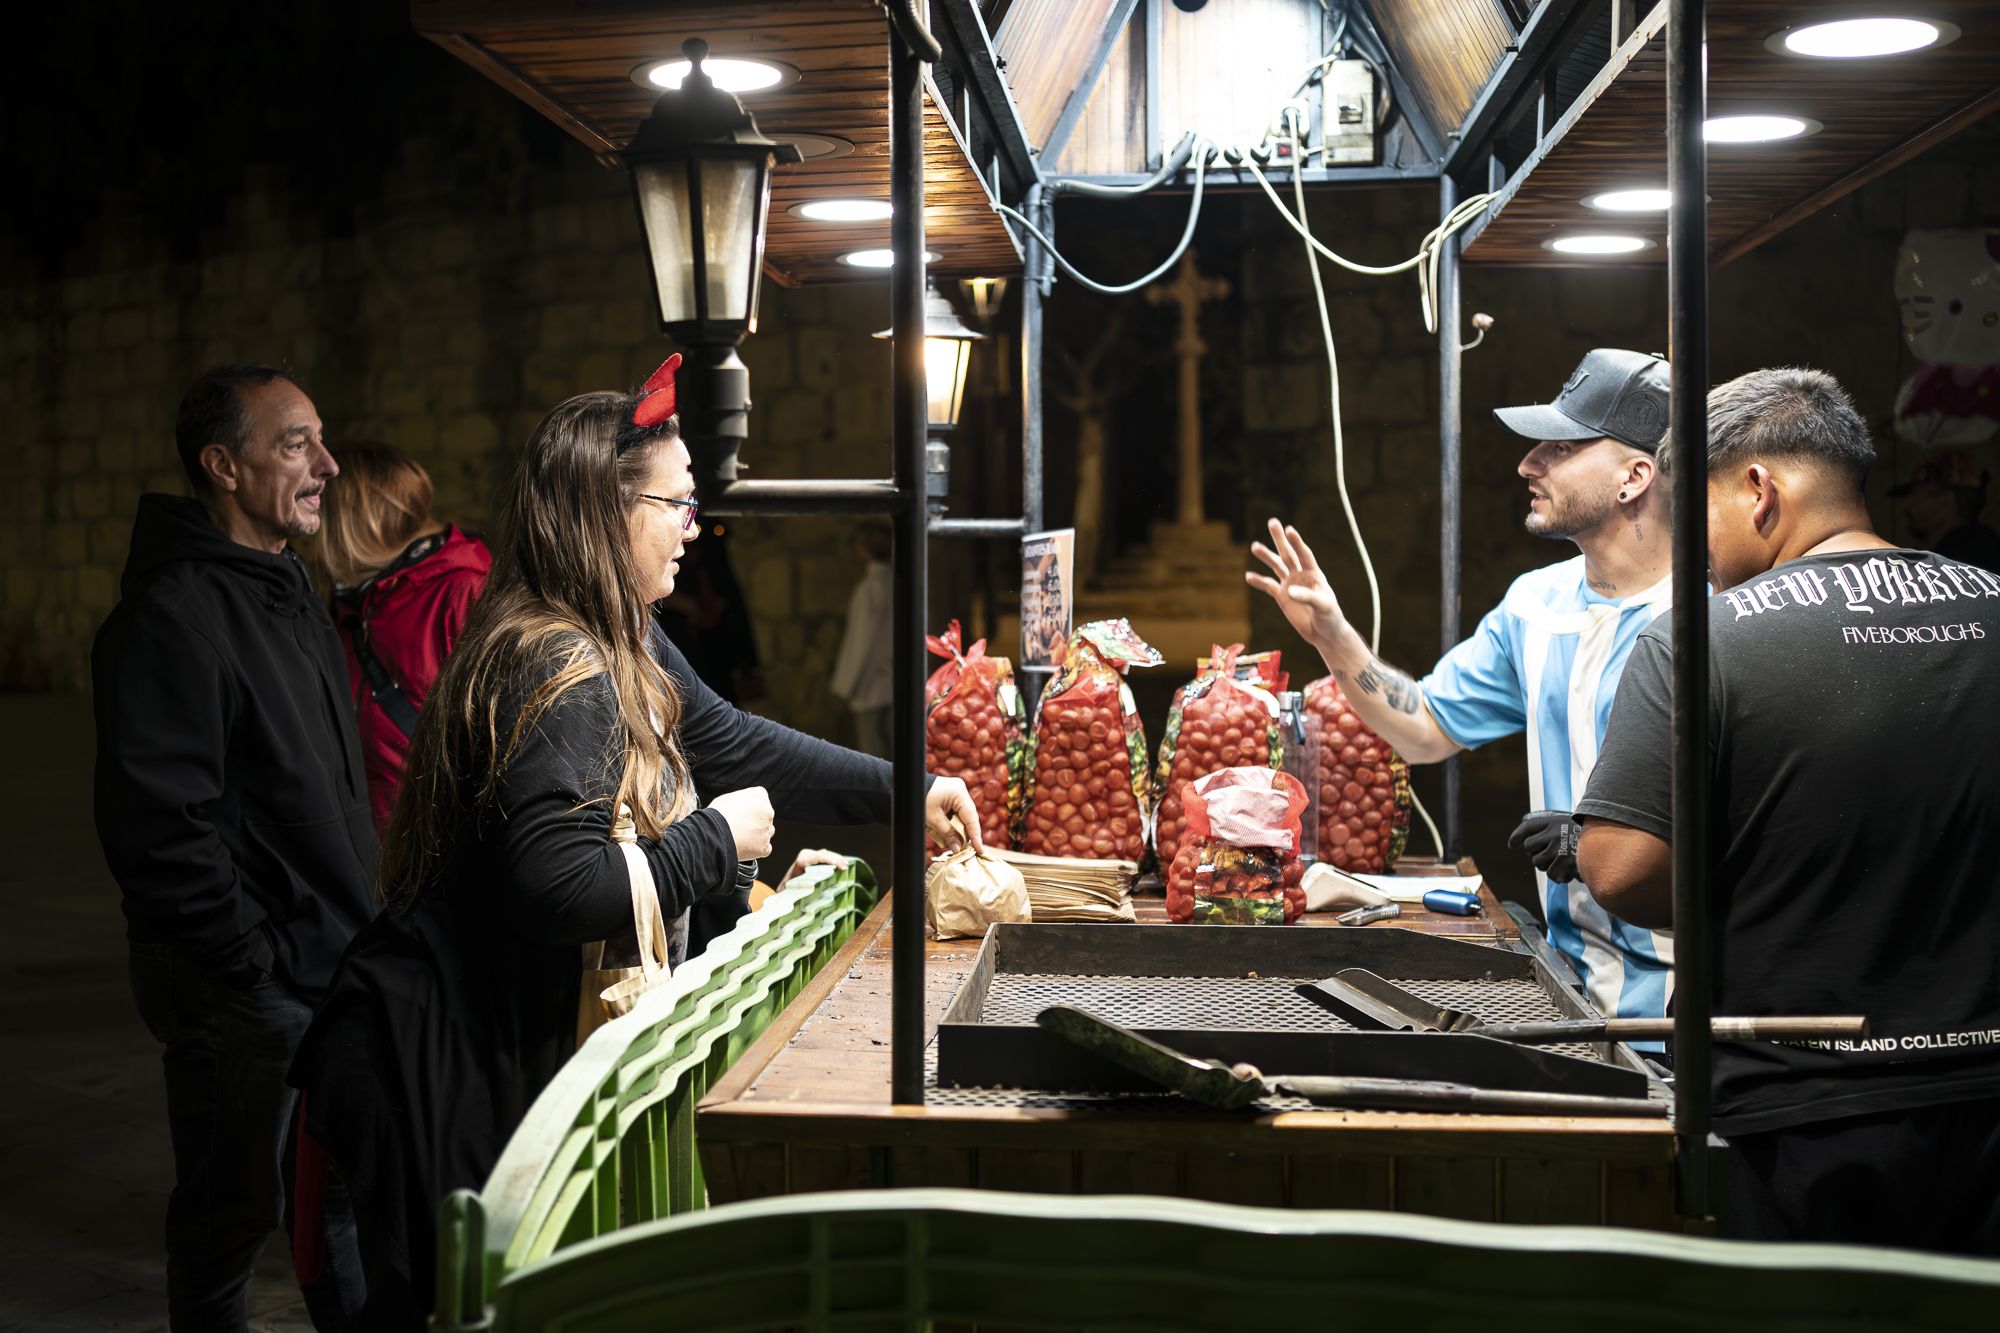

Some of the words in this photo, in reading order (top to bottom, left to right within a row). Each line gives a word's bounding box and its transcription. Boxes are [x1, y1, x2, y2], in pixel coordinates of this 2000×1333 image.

[1721, 568, 1827, 622] NEW
[1834, 1037, 1898, 1052] ISLAND
[1900, 1029, 2000, 1050] COLLECTIVE
